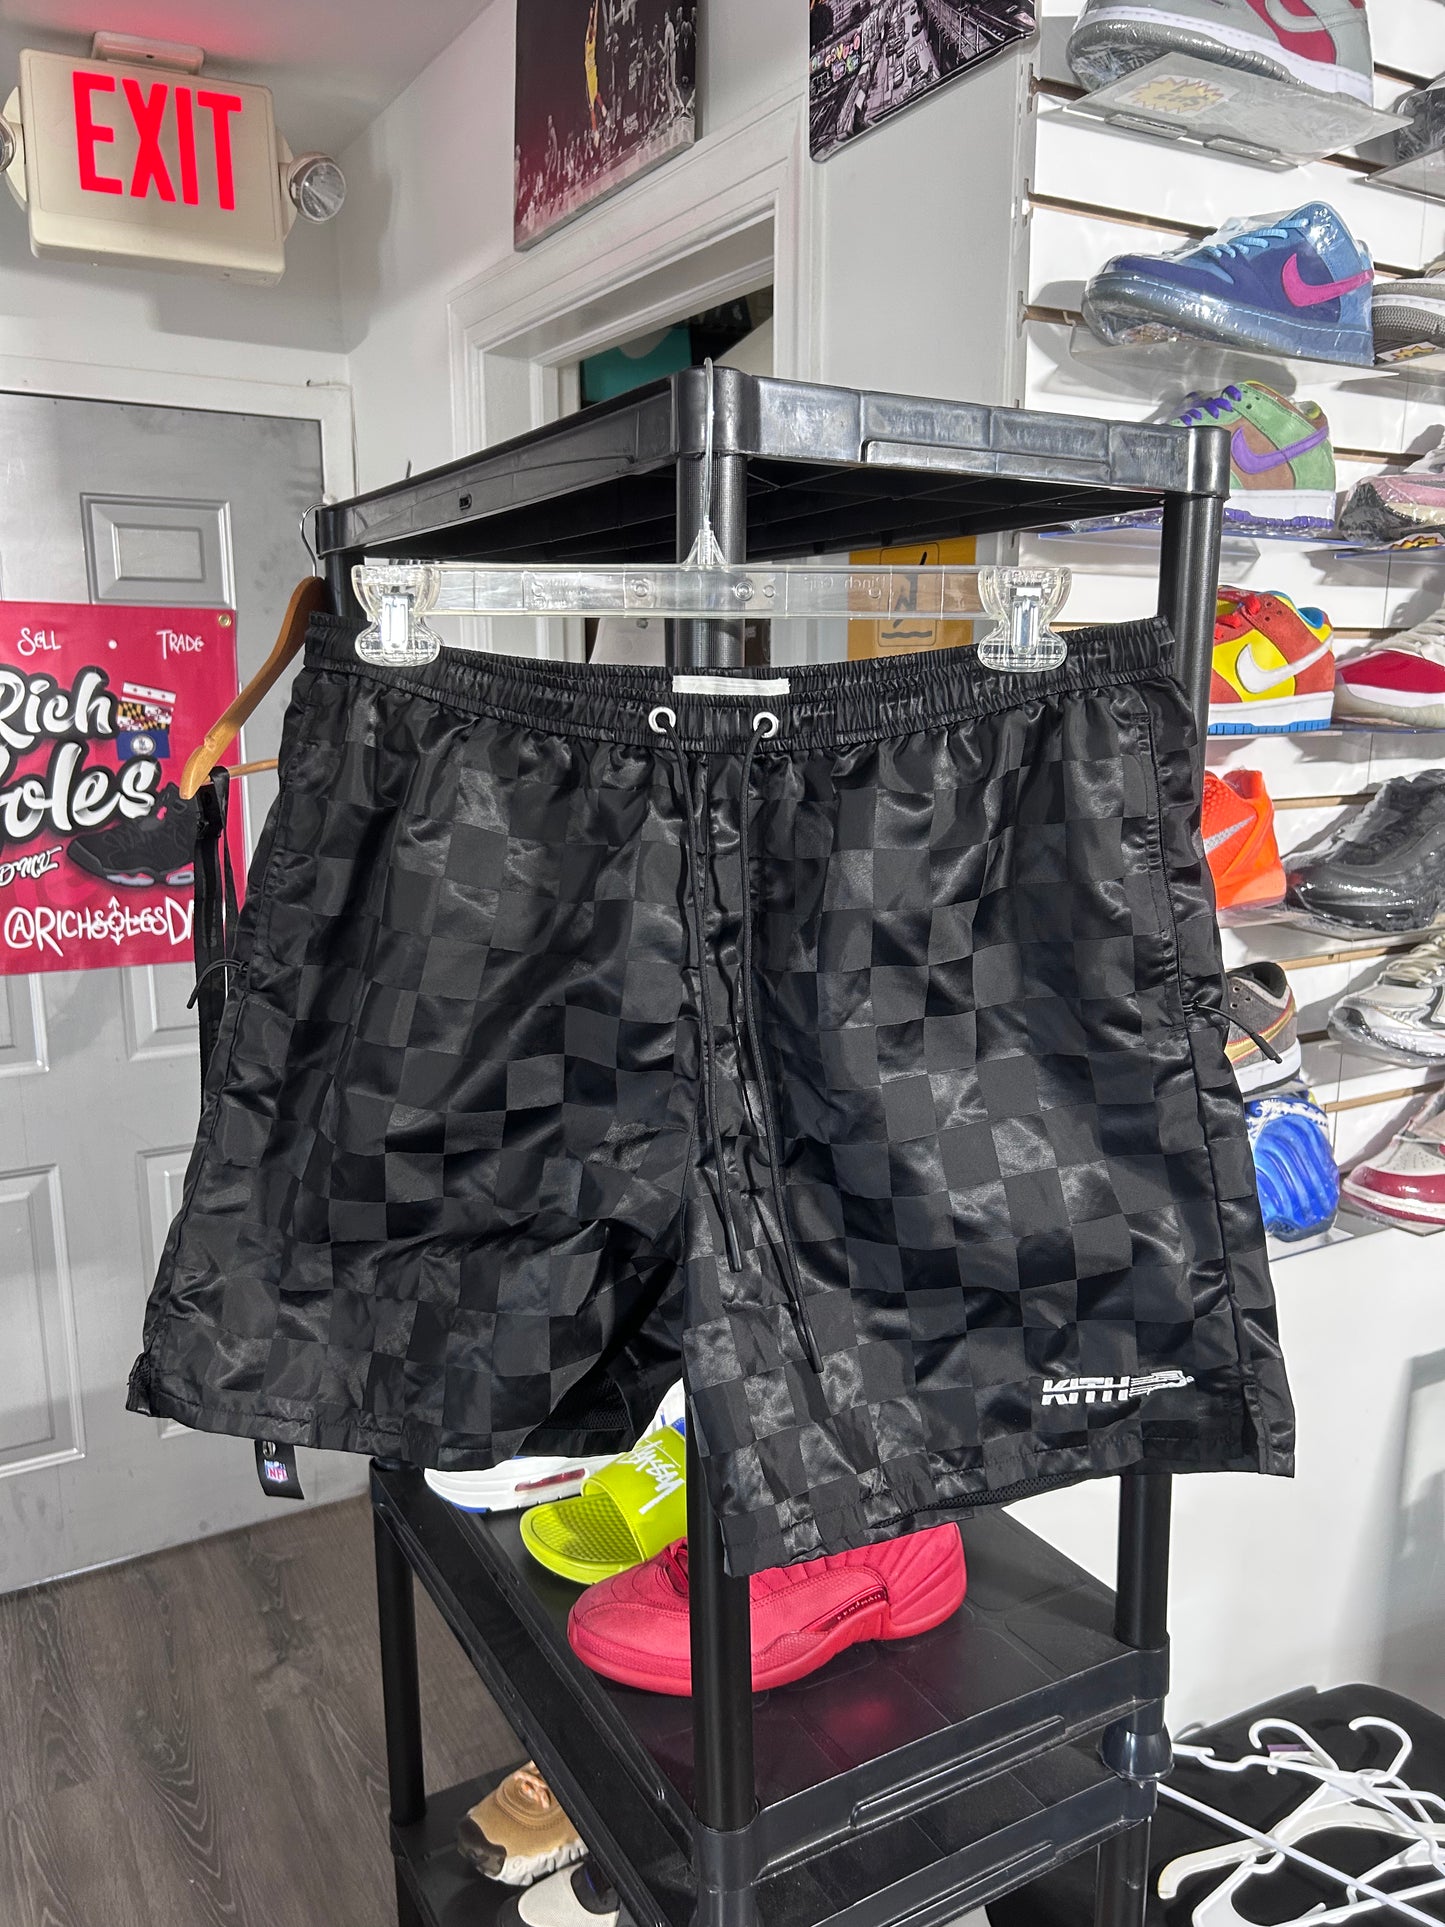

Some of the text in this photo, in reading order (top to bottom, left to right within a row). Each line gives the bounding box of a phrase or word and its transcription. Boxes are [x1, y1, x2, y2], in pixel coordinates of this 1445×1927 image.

[72, 71, 242, 211] EXIT
[156, 629, 204, 660] TRADE
[1041, 1376, 1131, 1406] KITH
[268, 1467, 288, 1481] NFL
